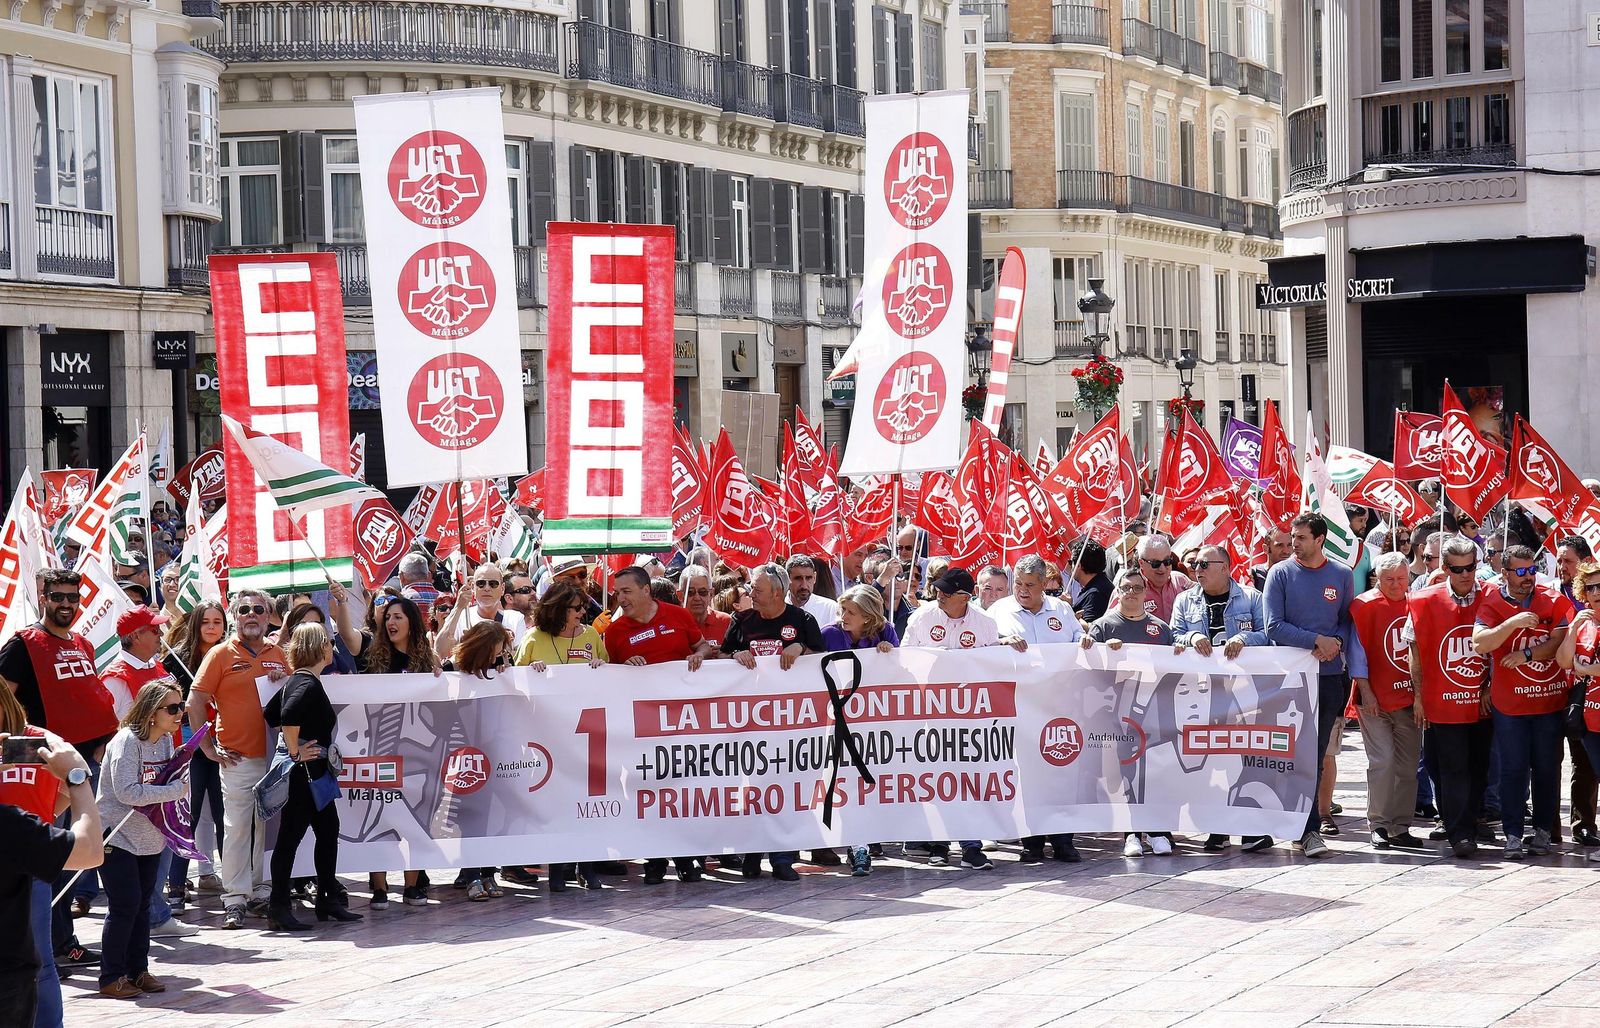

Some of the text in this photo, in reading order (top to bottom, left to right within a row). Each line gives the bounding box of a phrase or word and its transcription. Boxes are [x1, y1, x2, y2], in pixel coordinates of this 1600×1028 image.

[408, 144, 462, 174] UGT
[898, 145, 939, 176] UGT
[422, 214, 461, 225] Málaga
[905, 215, 933, 227] Málaga
[418, 255, 472, 284] UGT
[897, 255, 938, 287] UGT
[1347, 277, 1394, 298] SECRET
[431, 325, 470, 336] Málaga
[902, 323, 931, 336] Málaga
[157, 340, 187, 350] NYX
[51, 352, 92, 374] NYX
[427, 366, 480, 396] UGT
[567, 236, 644, 516] CCOO
[894, 363, 933, 395] UGT
[440, 436, 478, 447] Málaga
[795, 427, 821, 462] UGT
[890, 430, 922, 442] Málaga
[1448, 414, 1487, 469] UGT
[82, 597, 114, 637] álaga
[1442, 691, 1470, 700] mano
[1514, 685, 1541, 694] mano
[1548, 680, 1568, 691] man
[658, 704, 700, 731] LA
[710, 697, 818, 730] LUCHA
[1584, 699, 1600, 710] ano
[1045, 725, 1078, 746] UGT
[1087, 731, 1135, 743] Andalucía
[1188, 729, 1270, 750] CCOO
[575, 707, 607, 797] 1
[340, 762, 377, 784] OO
[446, 753, 485, 776] UGT
[496, 757, 542, 772] Andalucía
[1243, 754, 1295, 772] Málaga
[348, 787, 403, 804] Málaga
[636, 769, 1016, 820] PRIMERO LAS PERSONAS
[577, 800, 622, 819] MAYO
